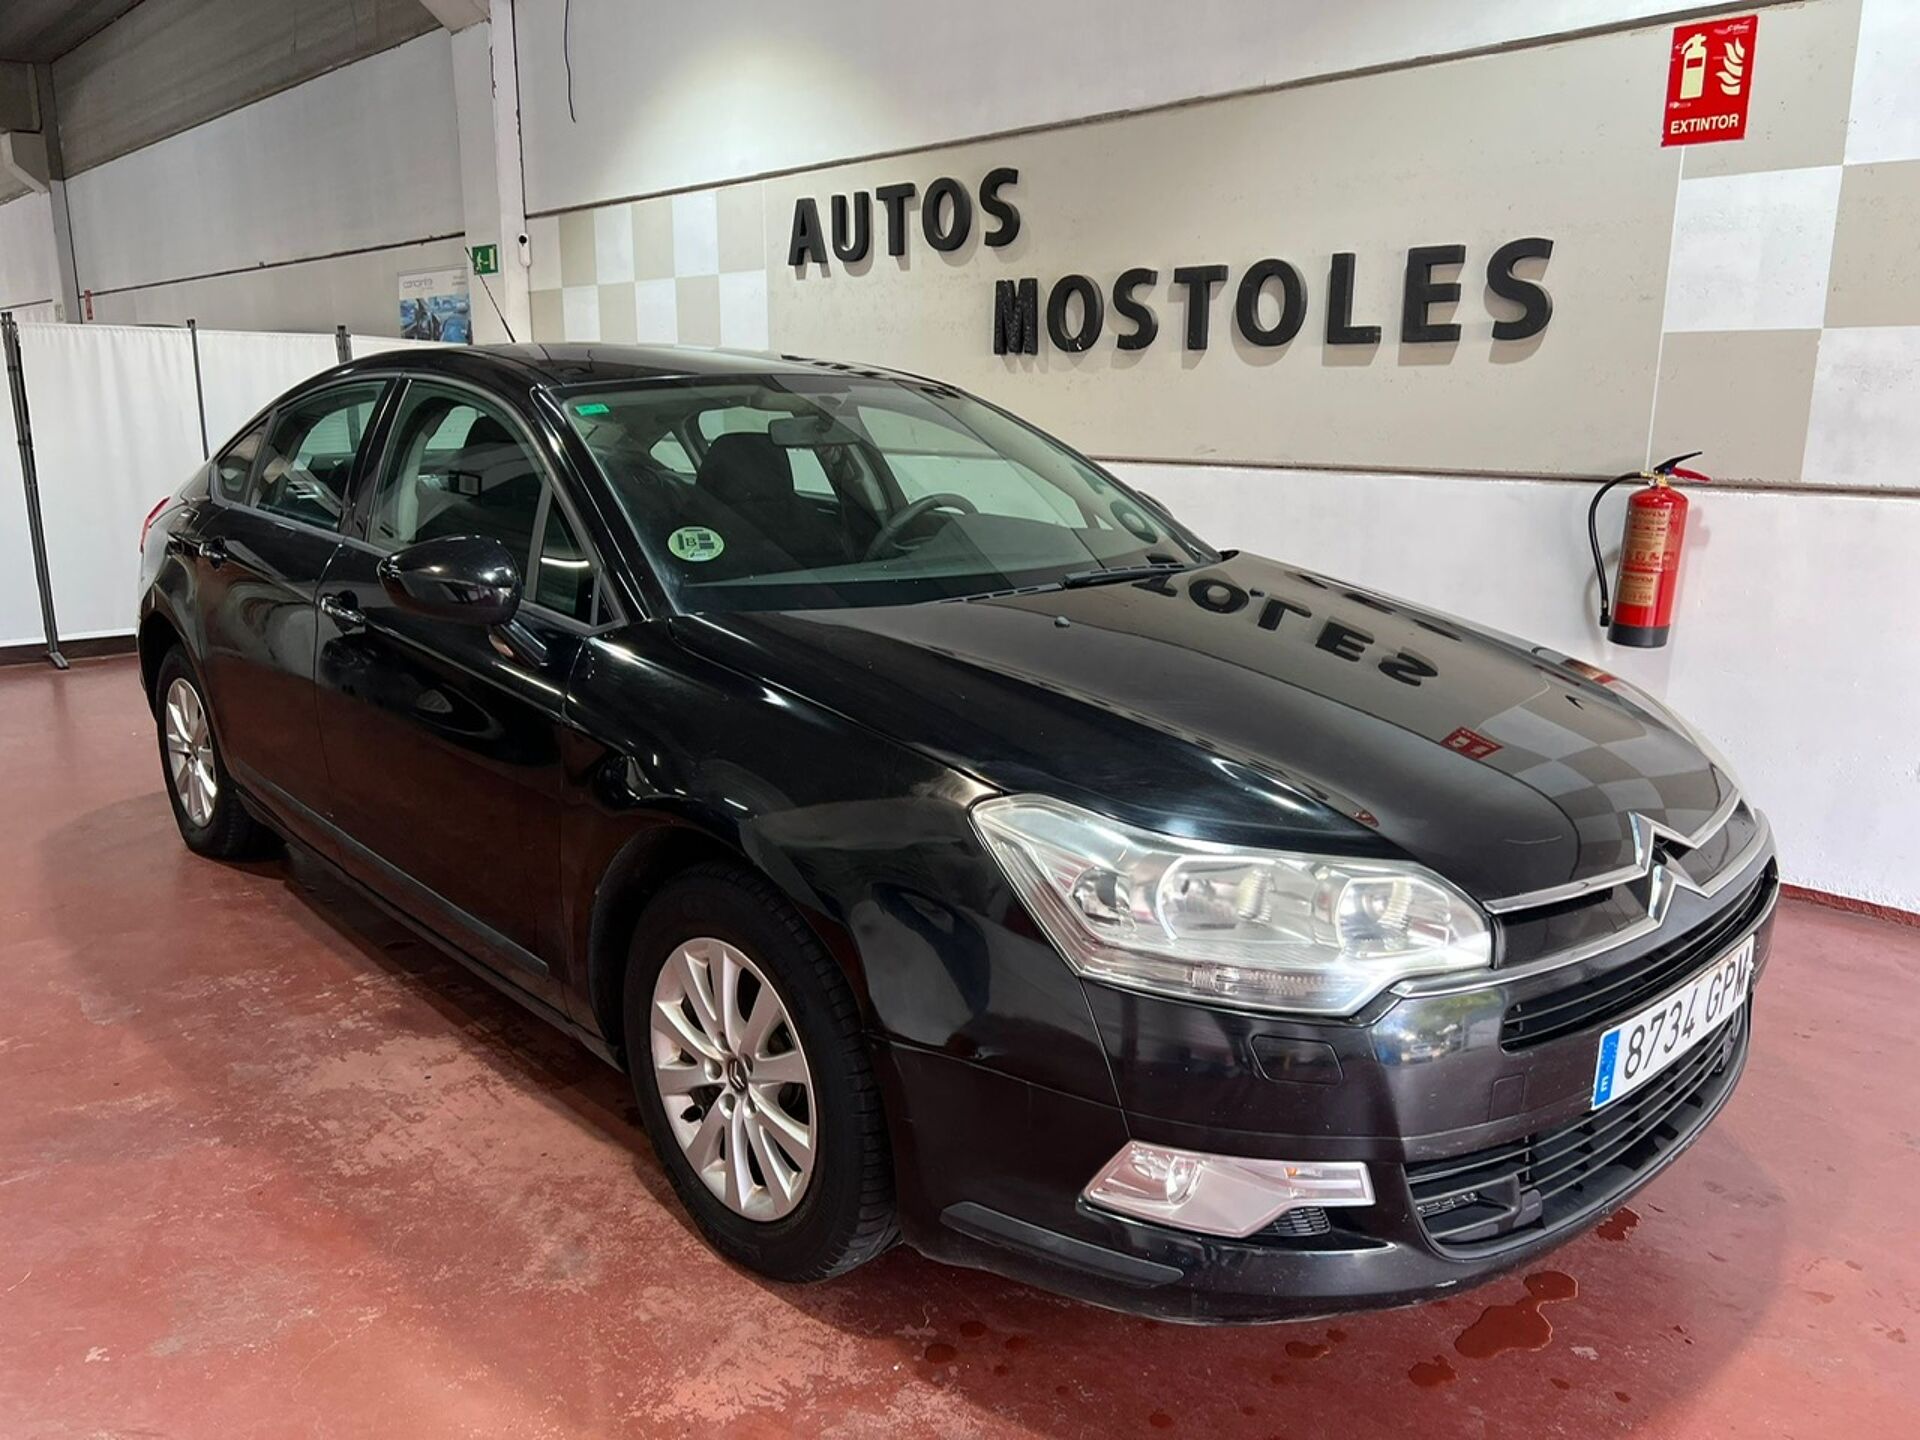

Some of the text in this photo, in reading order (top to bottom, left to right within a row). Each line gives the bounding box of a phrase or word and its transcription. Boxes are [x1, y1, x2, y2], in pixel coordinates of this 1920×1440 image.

[1670, 113, 1740, 135] EXTINTOR
[788, 167, 1021, 266] AUTOS
[993, 237, 1554, 356] MOSTOLES
[1623, 946, 1750, 1080] 8734 GPM
